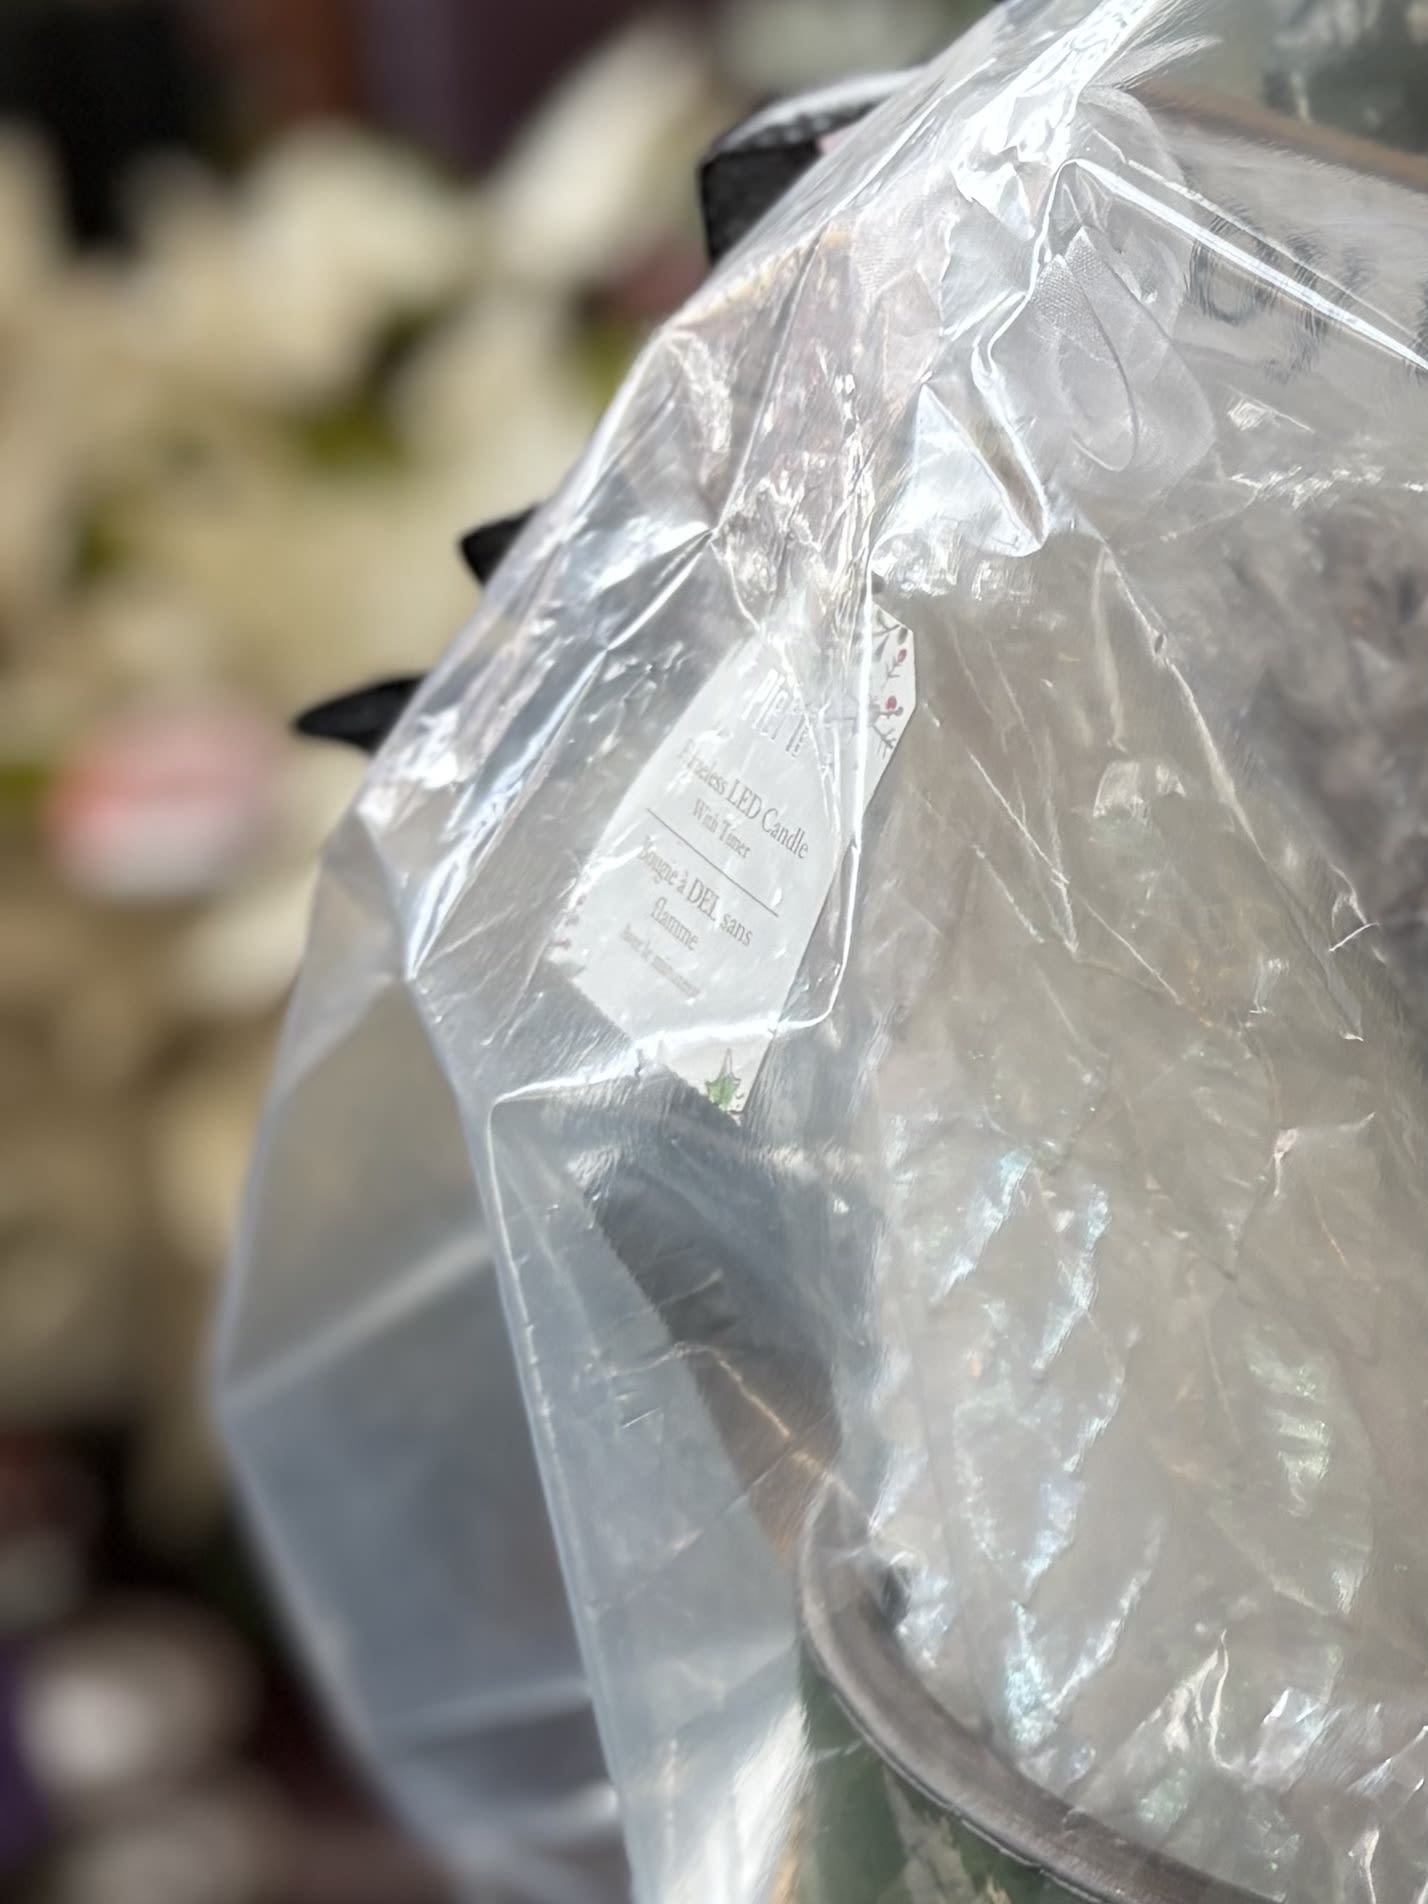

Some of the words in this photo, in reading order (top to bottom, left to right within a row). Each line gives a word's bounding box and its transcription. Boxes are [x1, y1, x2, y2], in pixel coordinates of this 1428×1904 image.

[692, 798, 719, 834] With
[727, 779, 762, 819] LED
[762, 807, 809, 860] Candle
[649, 896, 700, 951] flamme
[687, 878, 720, 922] DEL
[720, 914, 753, 947] sans
